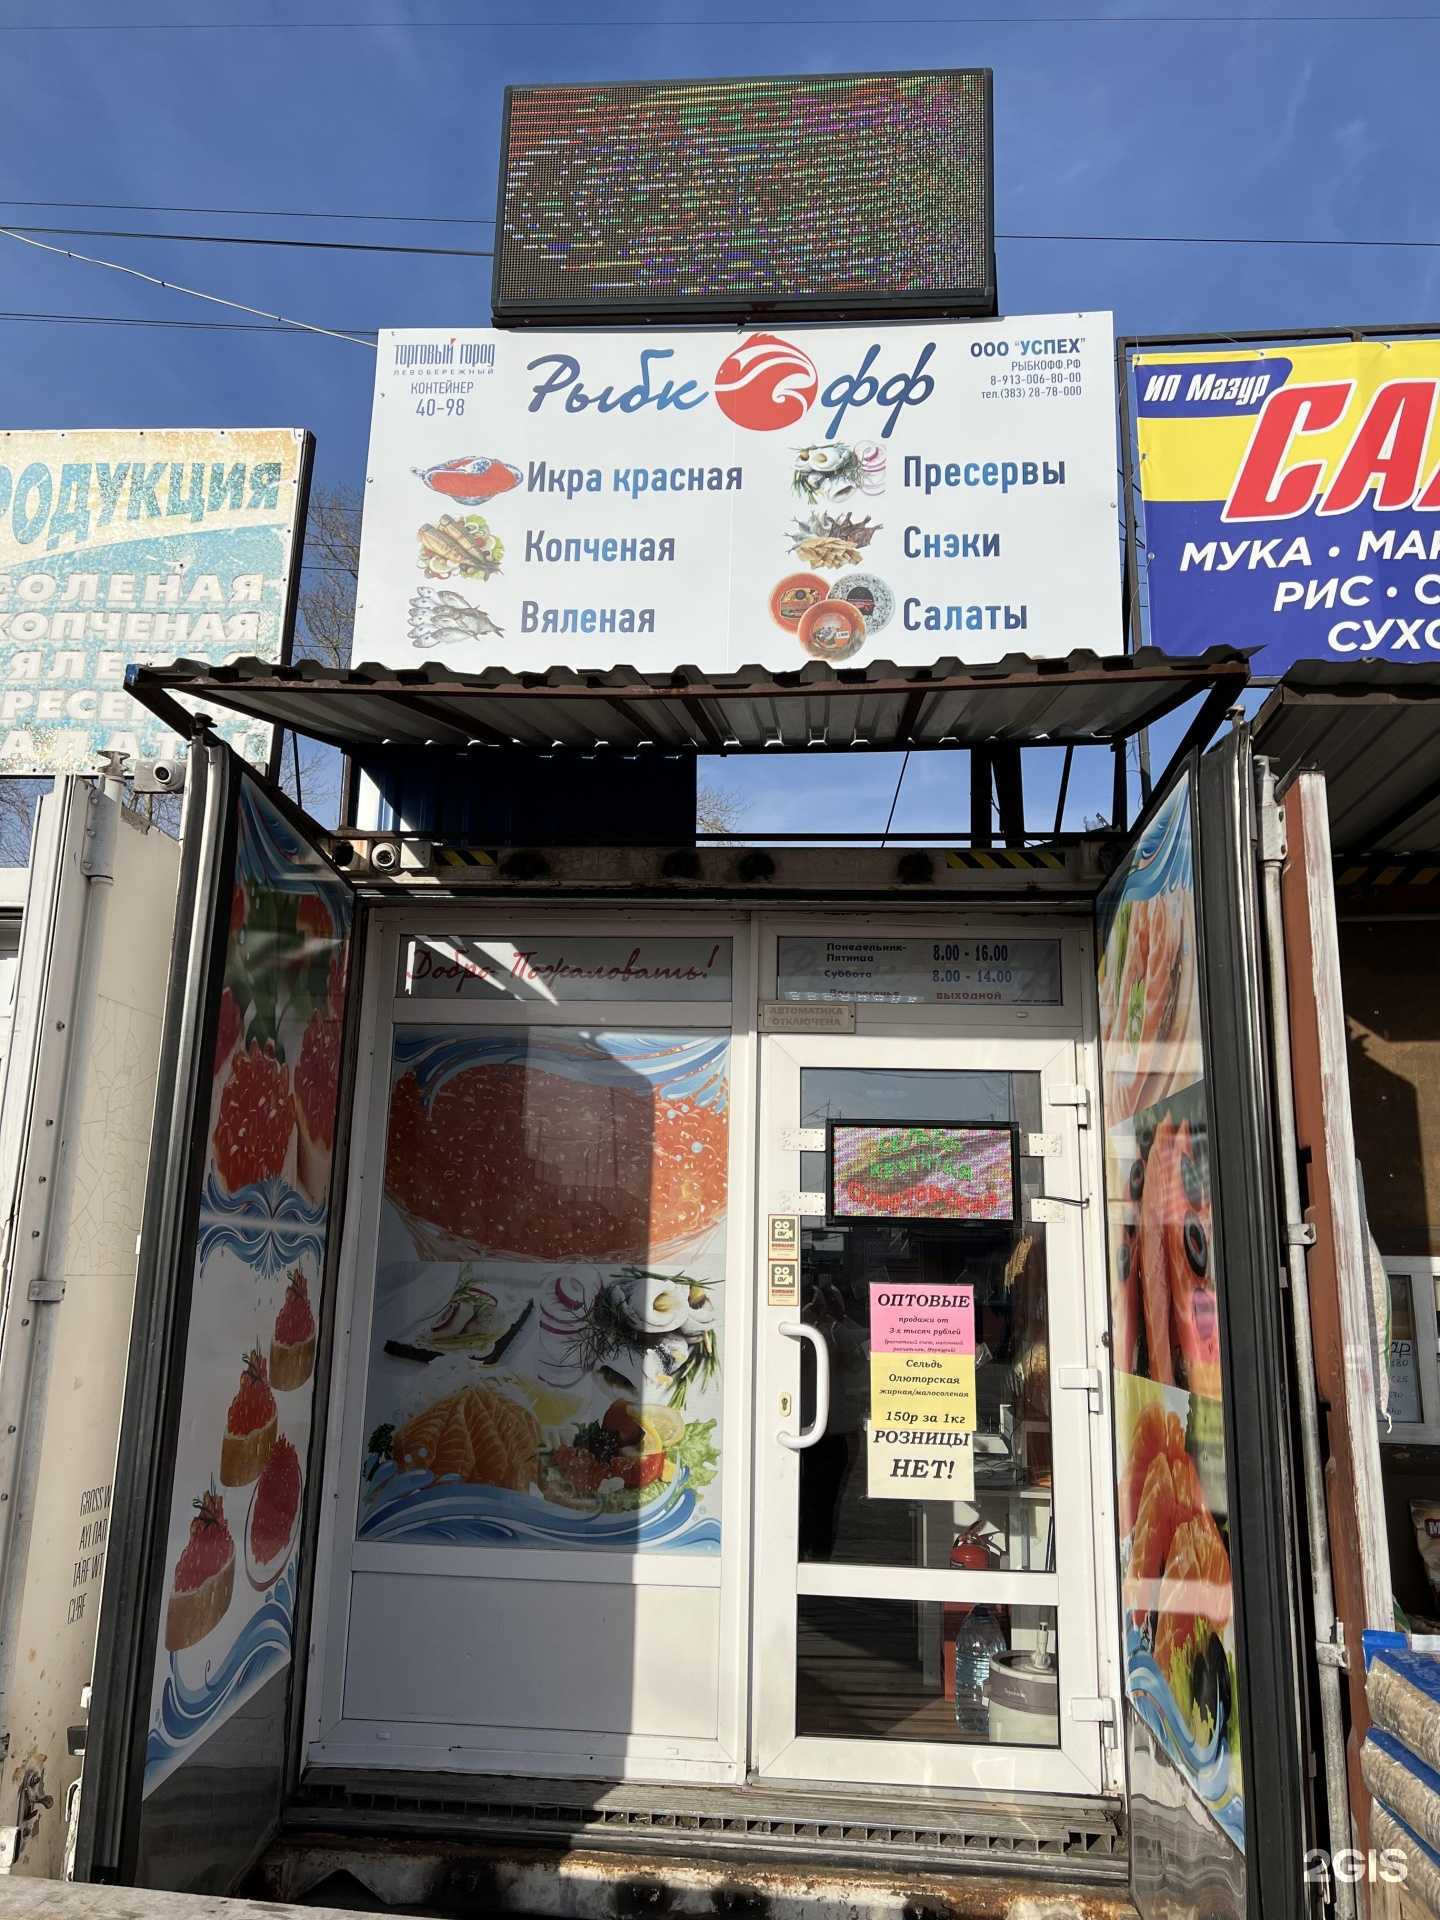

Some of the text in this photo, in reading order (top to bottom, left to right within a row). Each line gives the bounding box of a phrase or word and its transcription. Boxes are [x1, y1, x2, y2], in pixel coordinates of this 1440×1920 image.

[970, 341, 1009, 357] ООО
[1011, 359, 1081, 371] РЫБКОФФ.РФ
[411, 379, 474, 394] КОНТЕЙНЕР
[990, 372, 1081, 386] 8-913-006-80-00
[1144, 373, 1271, 406] ИП Мазур
[416, 398, 465, 417] 40-98
[527, 461, 743, 500] Икра красная
[903, 455, 1066, 494] Пресервы
[524, 530, 676, 562] Копченая
[903, 525, 1000, 558] Снэки
[1179, 536, 1312, 571] МУКА
[1273, 575, 1374, 612] РИС
[520, 601, 656, 633] Вяленая
[903, 598, 1029, 630] Салаты
[933, 944, 960, 961] 8.00
[976, 944, 1008, 961] 16.00
[824, 970, 872, 979] Суббота
[932, 970, 960, 982] 8.00
[877, 1293, 970, 1308] ОПТОВЫЕ
[906, 1359, 943, 1369] Сельдь
[889, 1373, 960, 1385] Олюторская
[922, 1415, 938, 1423] за
[943, 1413, 966, 1424] 1кг
[873, 1430, 970, 1447] РОЗНИЦЫ
[890, 1459, 955, 1479] НЕТ!
